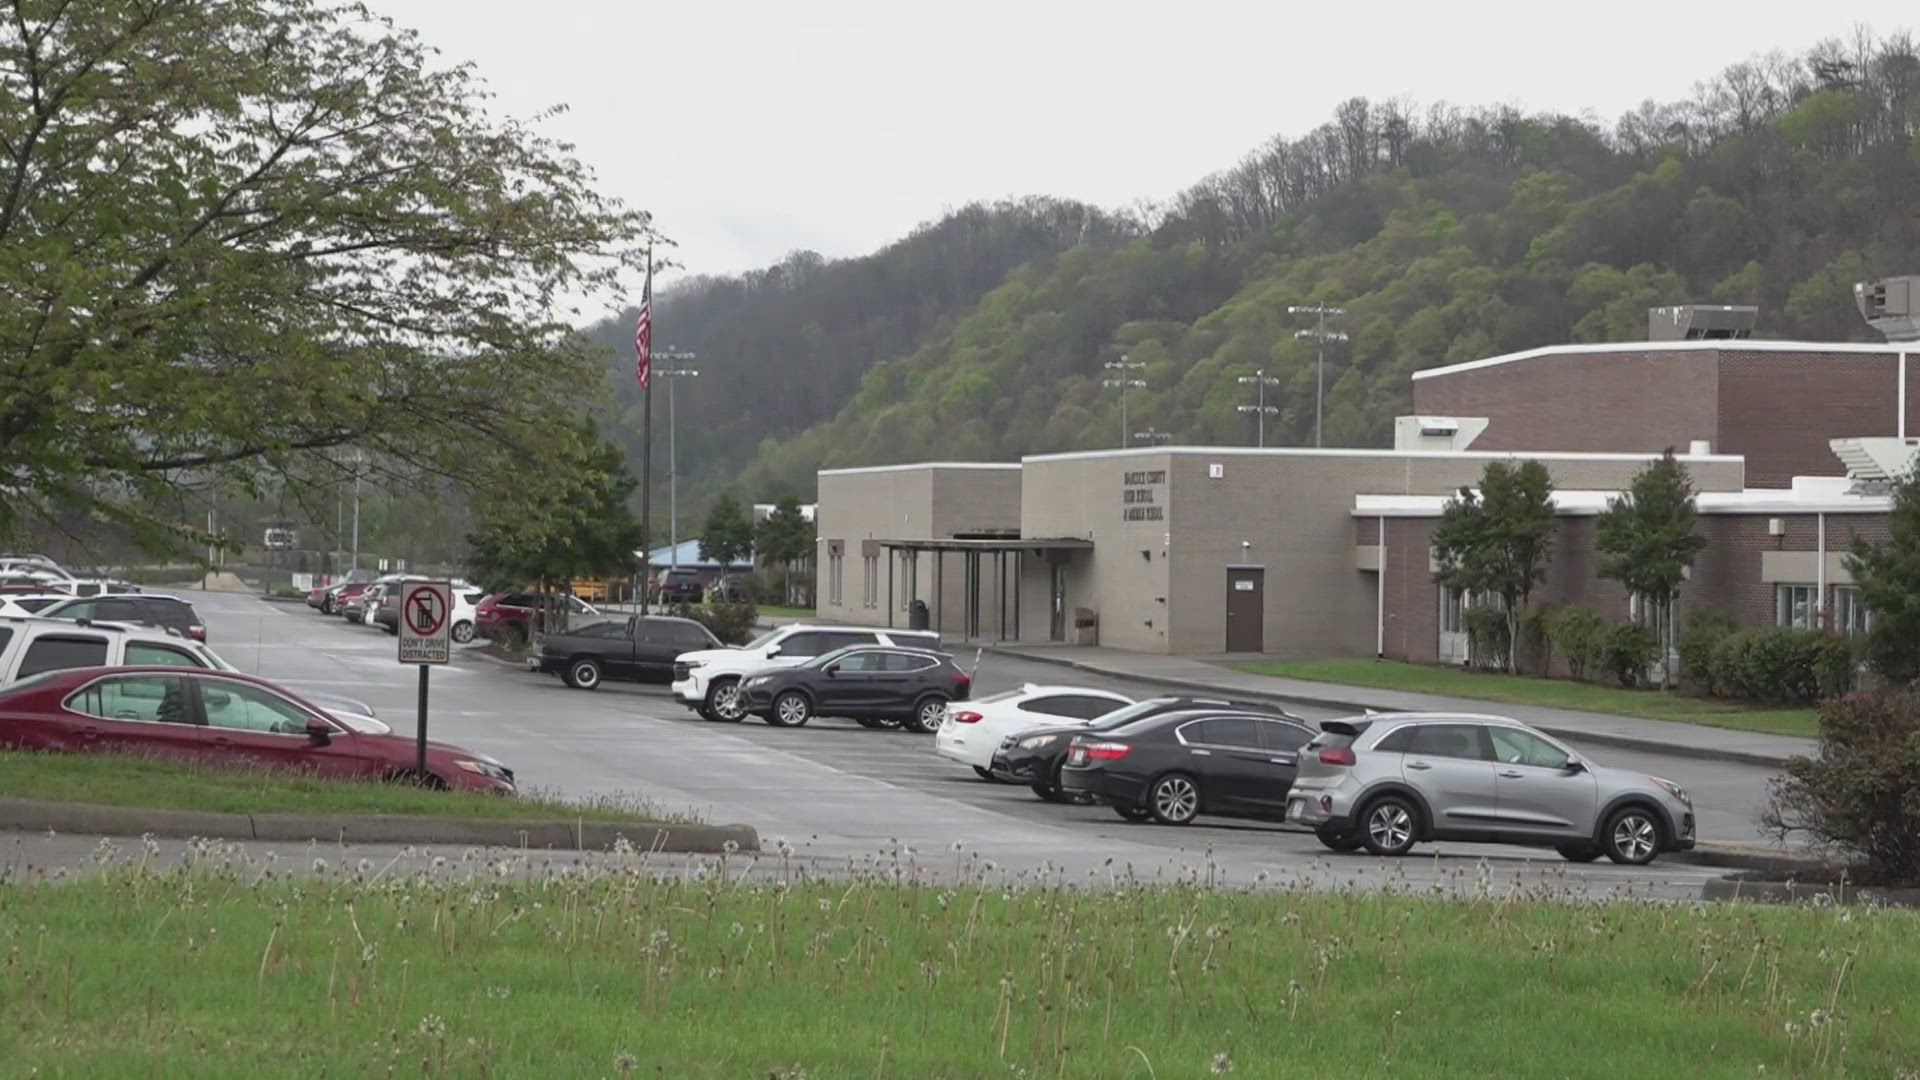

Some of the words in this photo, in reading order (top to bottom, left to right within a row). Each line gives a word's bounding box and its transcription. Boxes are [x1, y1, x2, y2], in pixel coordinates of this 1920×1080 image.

[402, 637, 423, 648] DON'T
[424, 637, 446, 649] DRIVE
[402, 649, 446, 660] DISTRACTED
